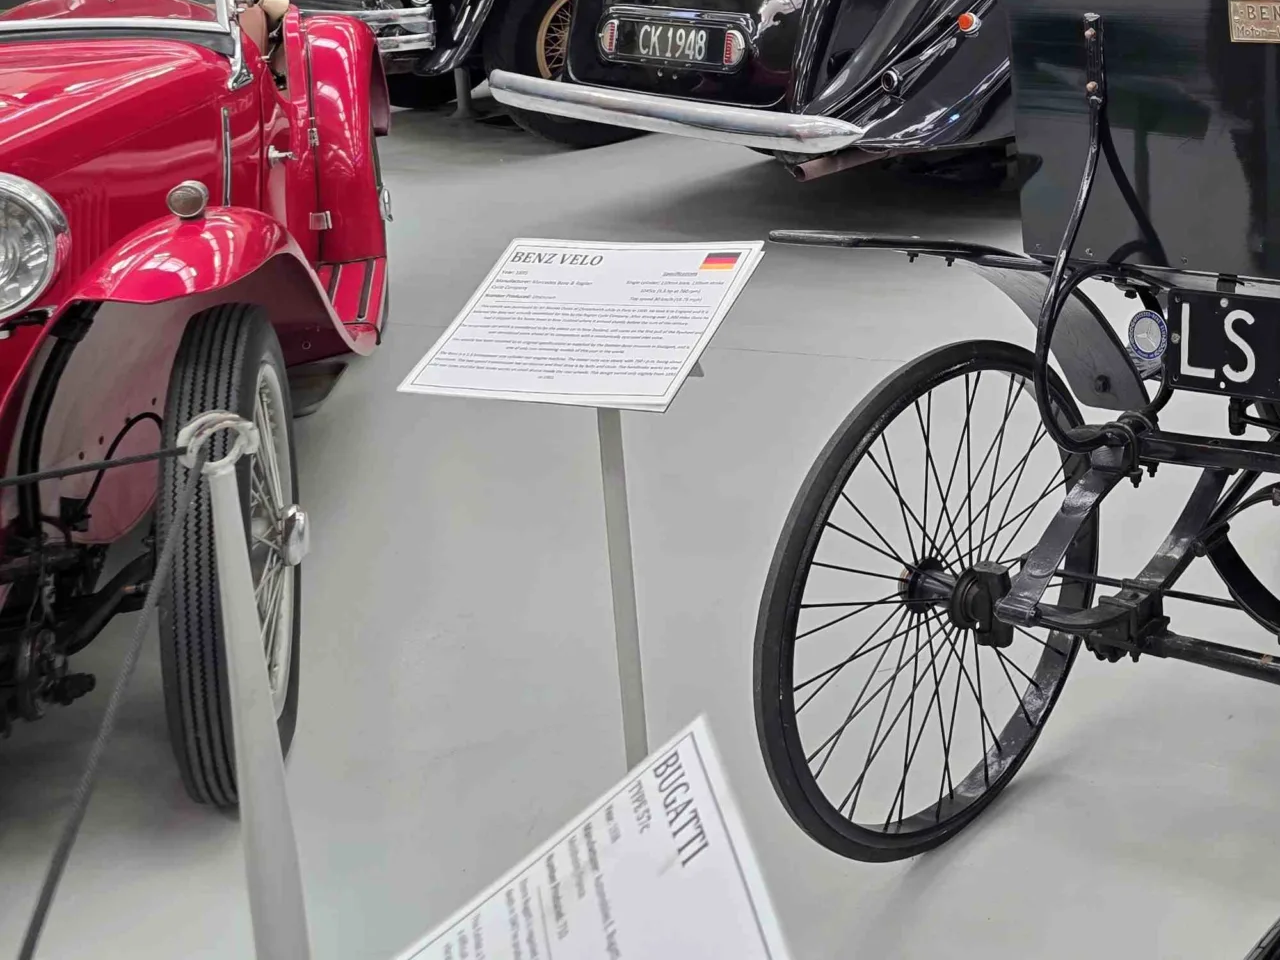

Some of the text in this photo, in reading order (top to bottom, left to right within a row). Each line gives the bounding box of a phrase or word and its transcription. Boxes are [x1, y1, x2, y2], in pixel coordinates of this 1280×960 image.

[639, 25, 707, 60] CK 1948
[510, 251, 604, 266] BENZ VELO
[1179, 302, 1256, 383] LS
[627, 779, 648, 814] TYPE
[652, 750, 710, 868] BUGATTI
